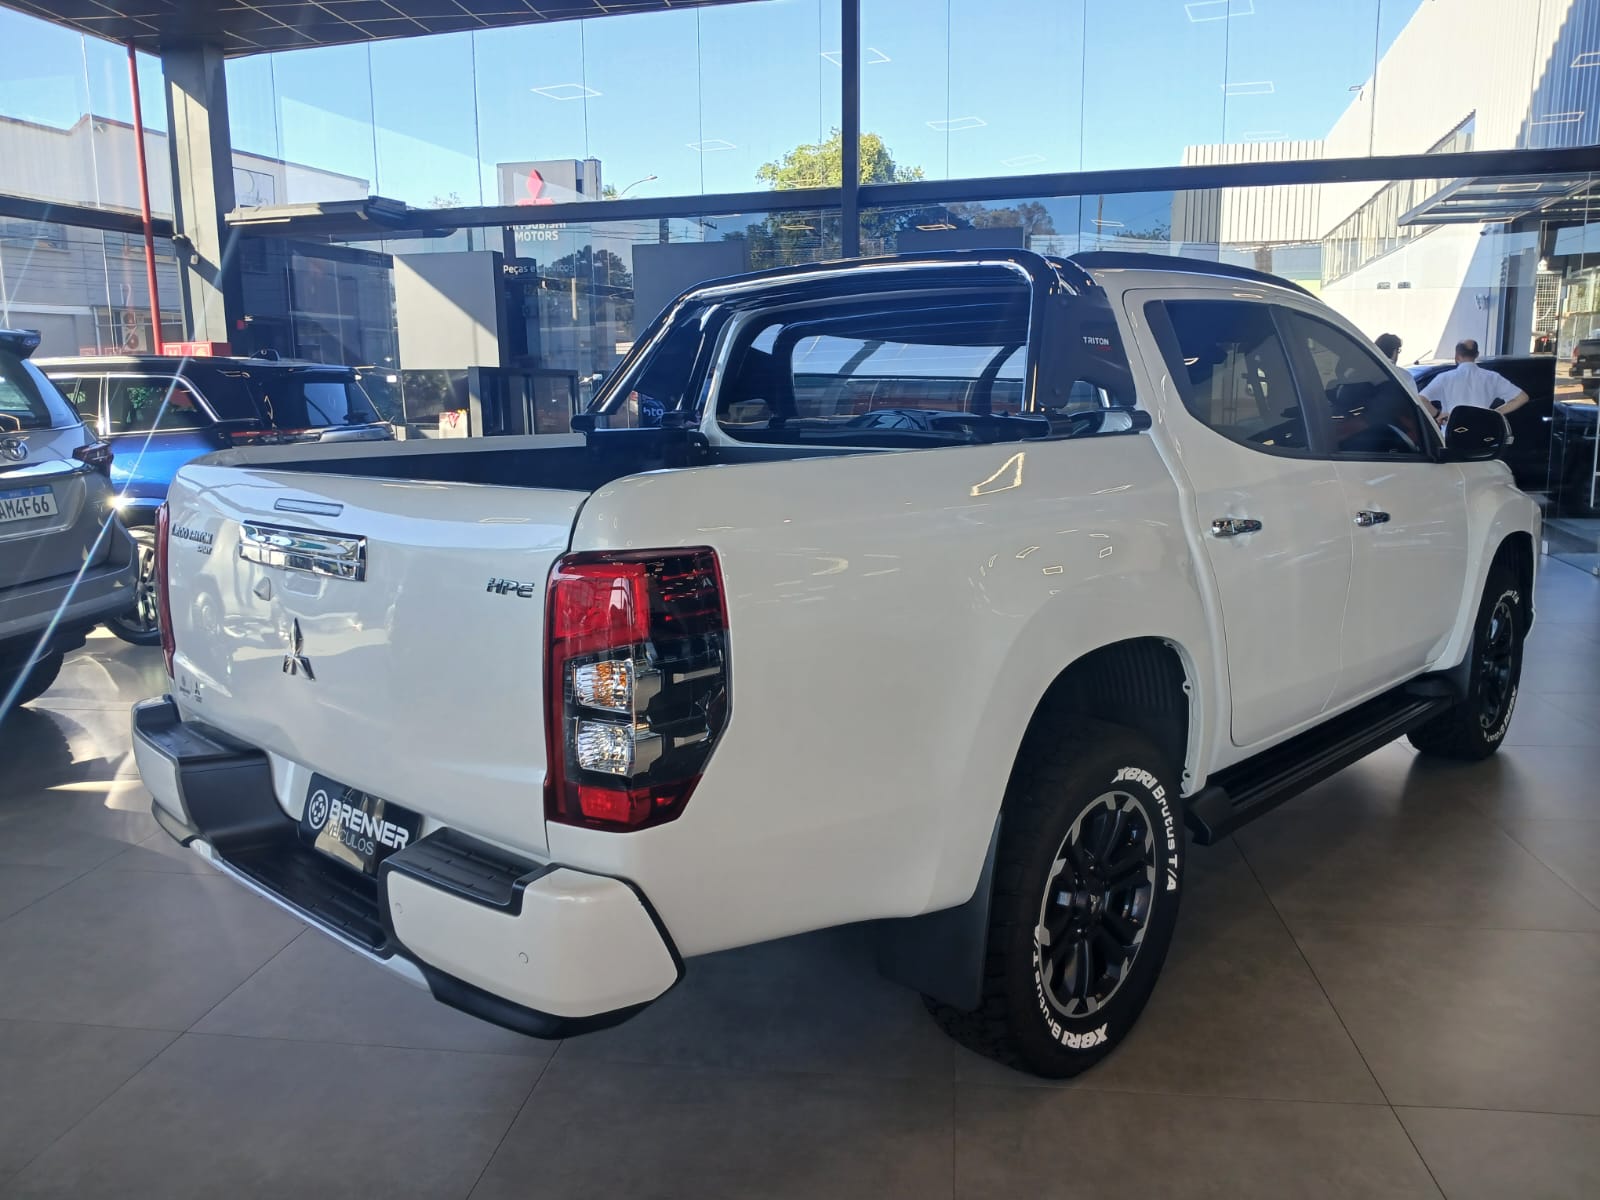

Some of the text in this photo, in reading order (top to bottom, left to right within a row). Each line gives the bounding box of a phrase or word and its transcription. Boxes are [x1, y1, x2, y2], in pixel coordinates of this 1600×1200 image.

[514, 230, 559, 241] MOTORS
[503, 264, 528, 275] Peças
[1082, 336, 1110, 346] TRITON
[486, 577, 535, 599] HPE
[329, 798, 410, 850] BRENNER
[1110, 766, 1178, 891] XBRI Brutus T/A
[1034, 970, 1062, 1040] Brutus
[1060, 1022, 1108, 1049] XBRI
